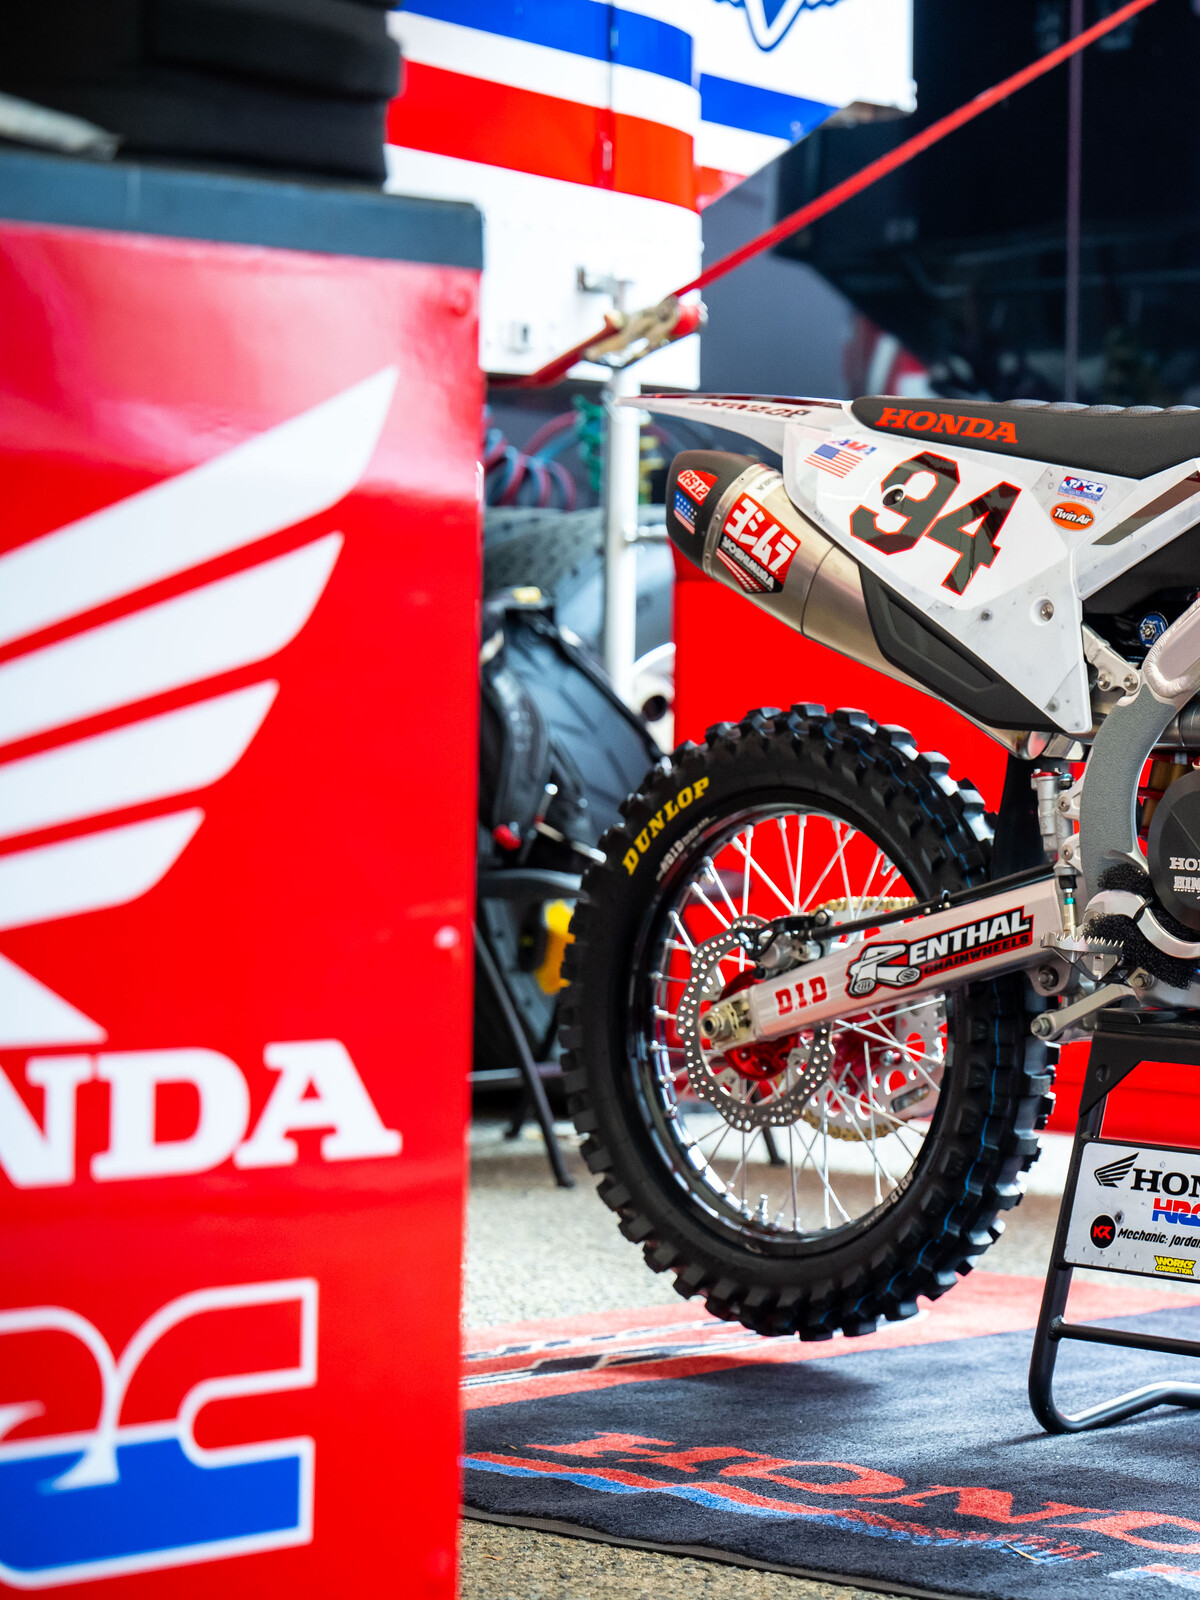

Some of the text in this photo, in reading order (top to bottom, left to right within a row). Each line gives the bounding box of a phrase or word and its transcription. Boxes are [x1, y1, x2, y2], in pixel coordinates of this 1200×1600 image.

[874, 406, 1018, 444] HONDA
[829, 438, 878, 456] AMA
[849, 450, 1023, 597] 94
[1053, 506, 1093, 526] Twin Air
[721, 535, 775, 591] YOSHIMURA
[622, 776, 710, 876] DUNLOP
[922, 933, 1030, 976] CHAINWHEELS
[1117, 1227, 1168, 1245] Mechanic:
[1155, 1256, 1196, 1268] WORKS
[1155, 1265, 1194, 1276] CONNECTION
